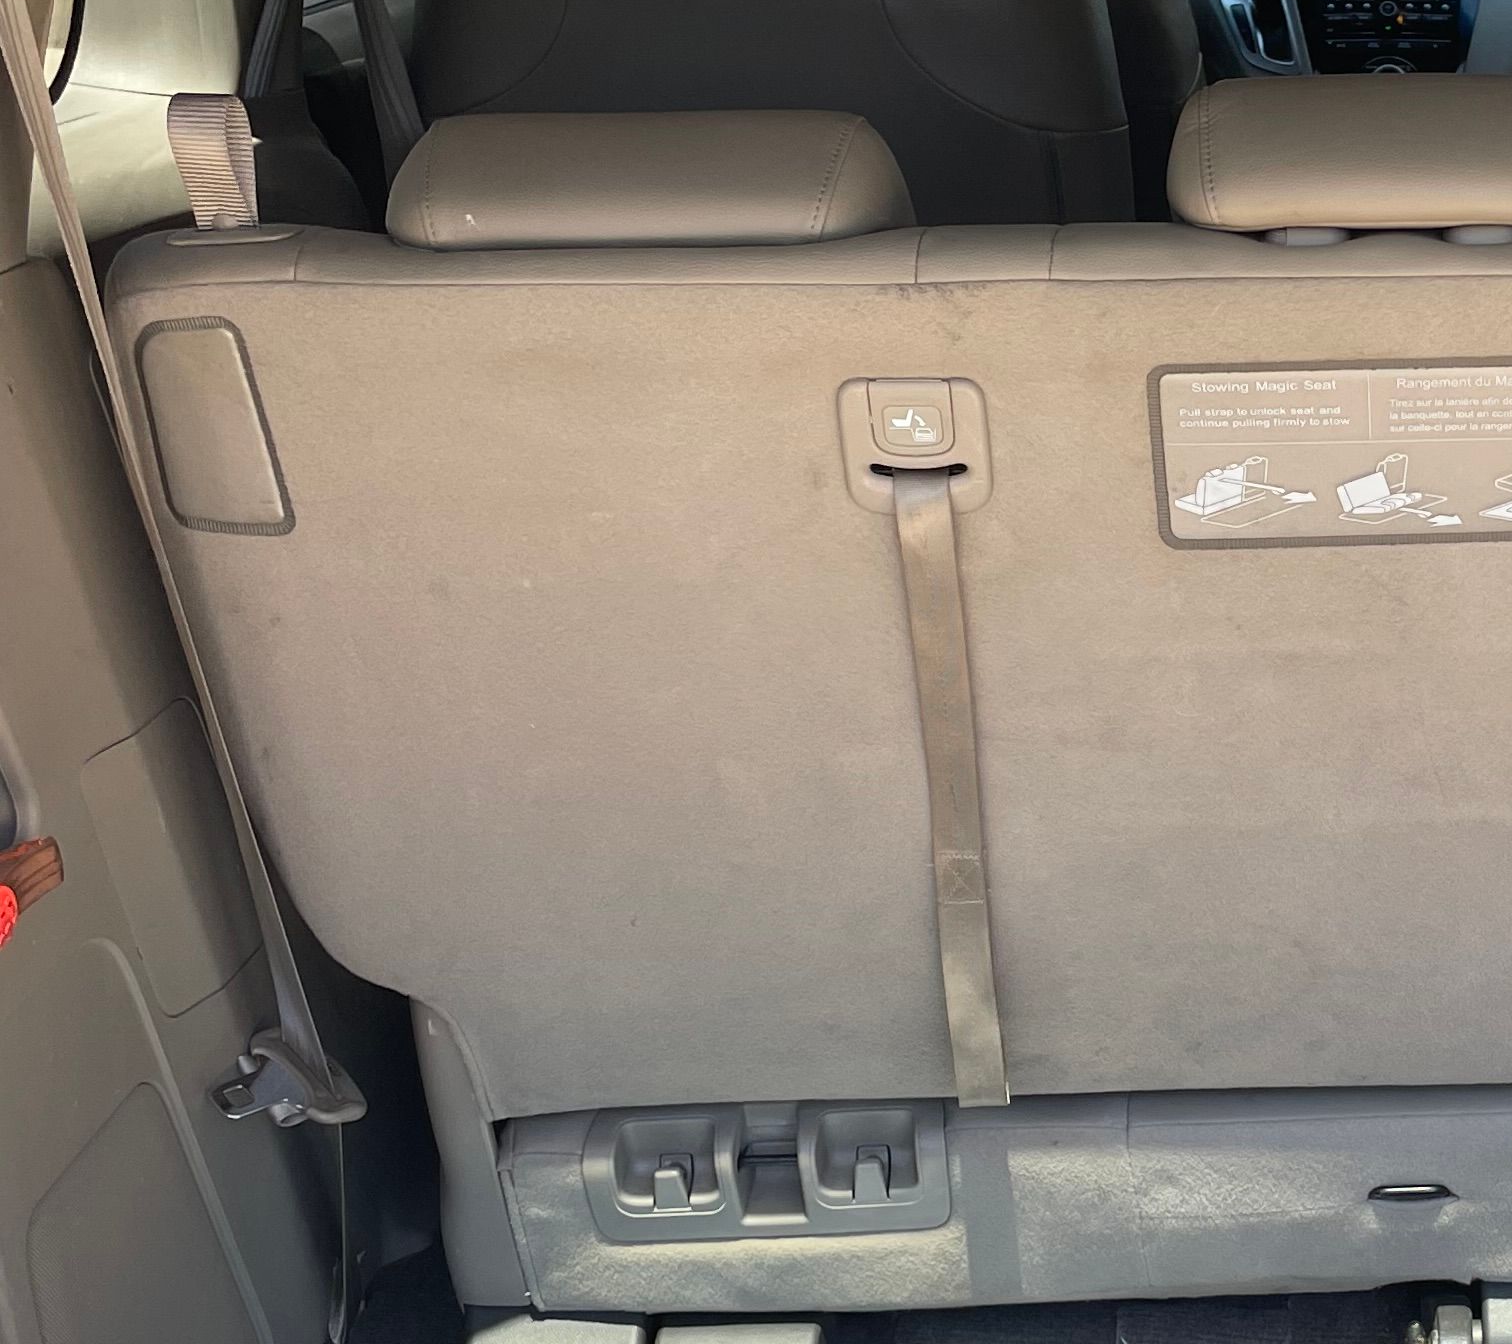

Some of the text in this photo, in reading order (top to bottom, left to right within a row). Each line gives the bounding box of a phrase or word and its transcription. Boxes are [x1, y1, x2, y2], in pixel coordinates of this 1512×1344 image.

[1191, 379, 1337, 394] Stowing Magic Seat
[1396, 377, 1471, 390] Rangement
[1474, 376, 1491, 387] du
[1389, 399, 1414, 408] Tirez
[1416, 400, 1432, 408] sur
[1434, 398, 1444, 407] la
[1482, 397, 1499, 406] afin
[1179, 406, 1341, 418] Pull strap to unlock seat and
[1389, 412, 1399, 420] la
[1455, 409, 1475, 418] tout
[1179, 417, 1351, 429] continue pulling firmly to stow
[1390, 425, 1405, 433] sur
[1445, 424, 1467, 434] pour
[1469, 422, 1479, 431] la
[1481, 423, 1512, 434] ranger
